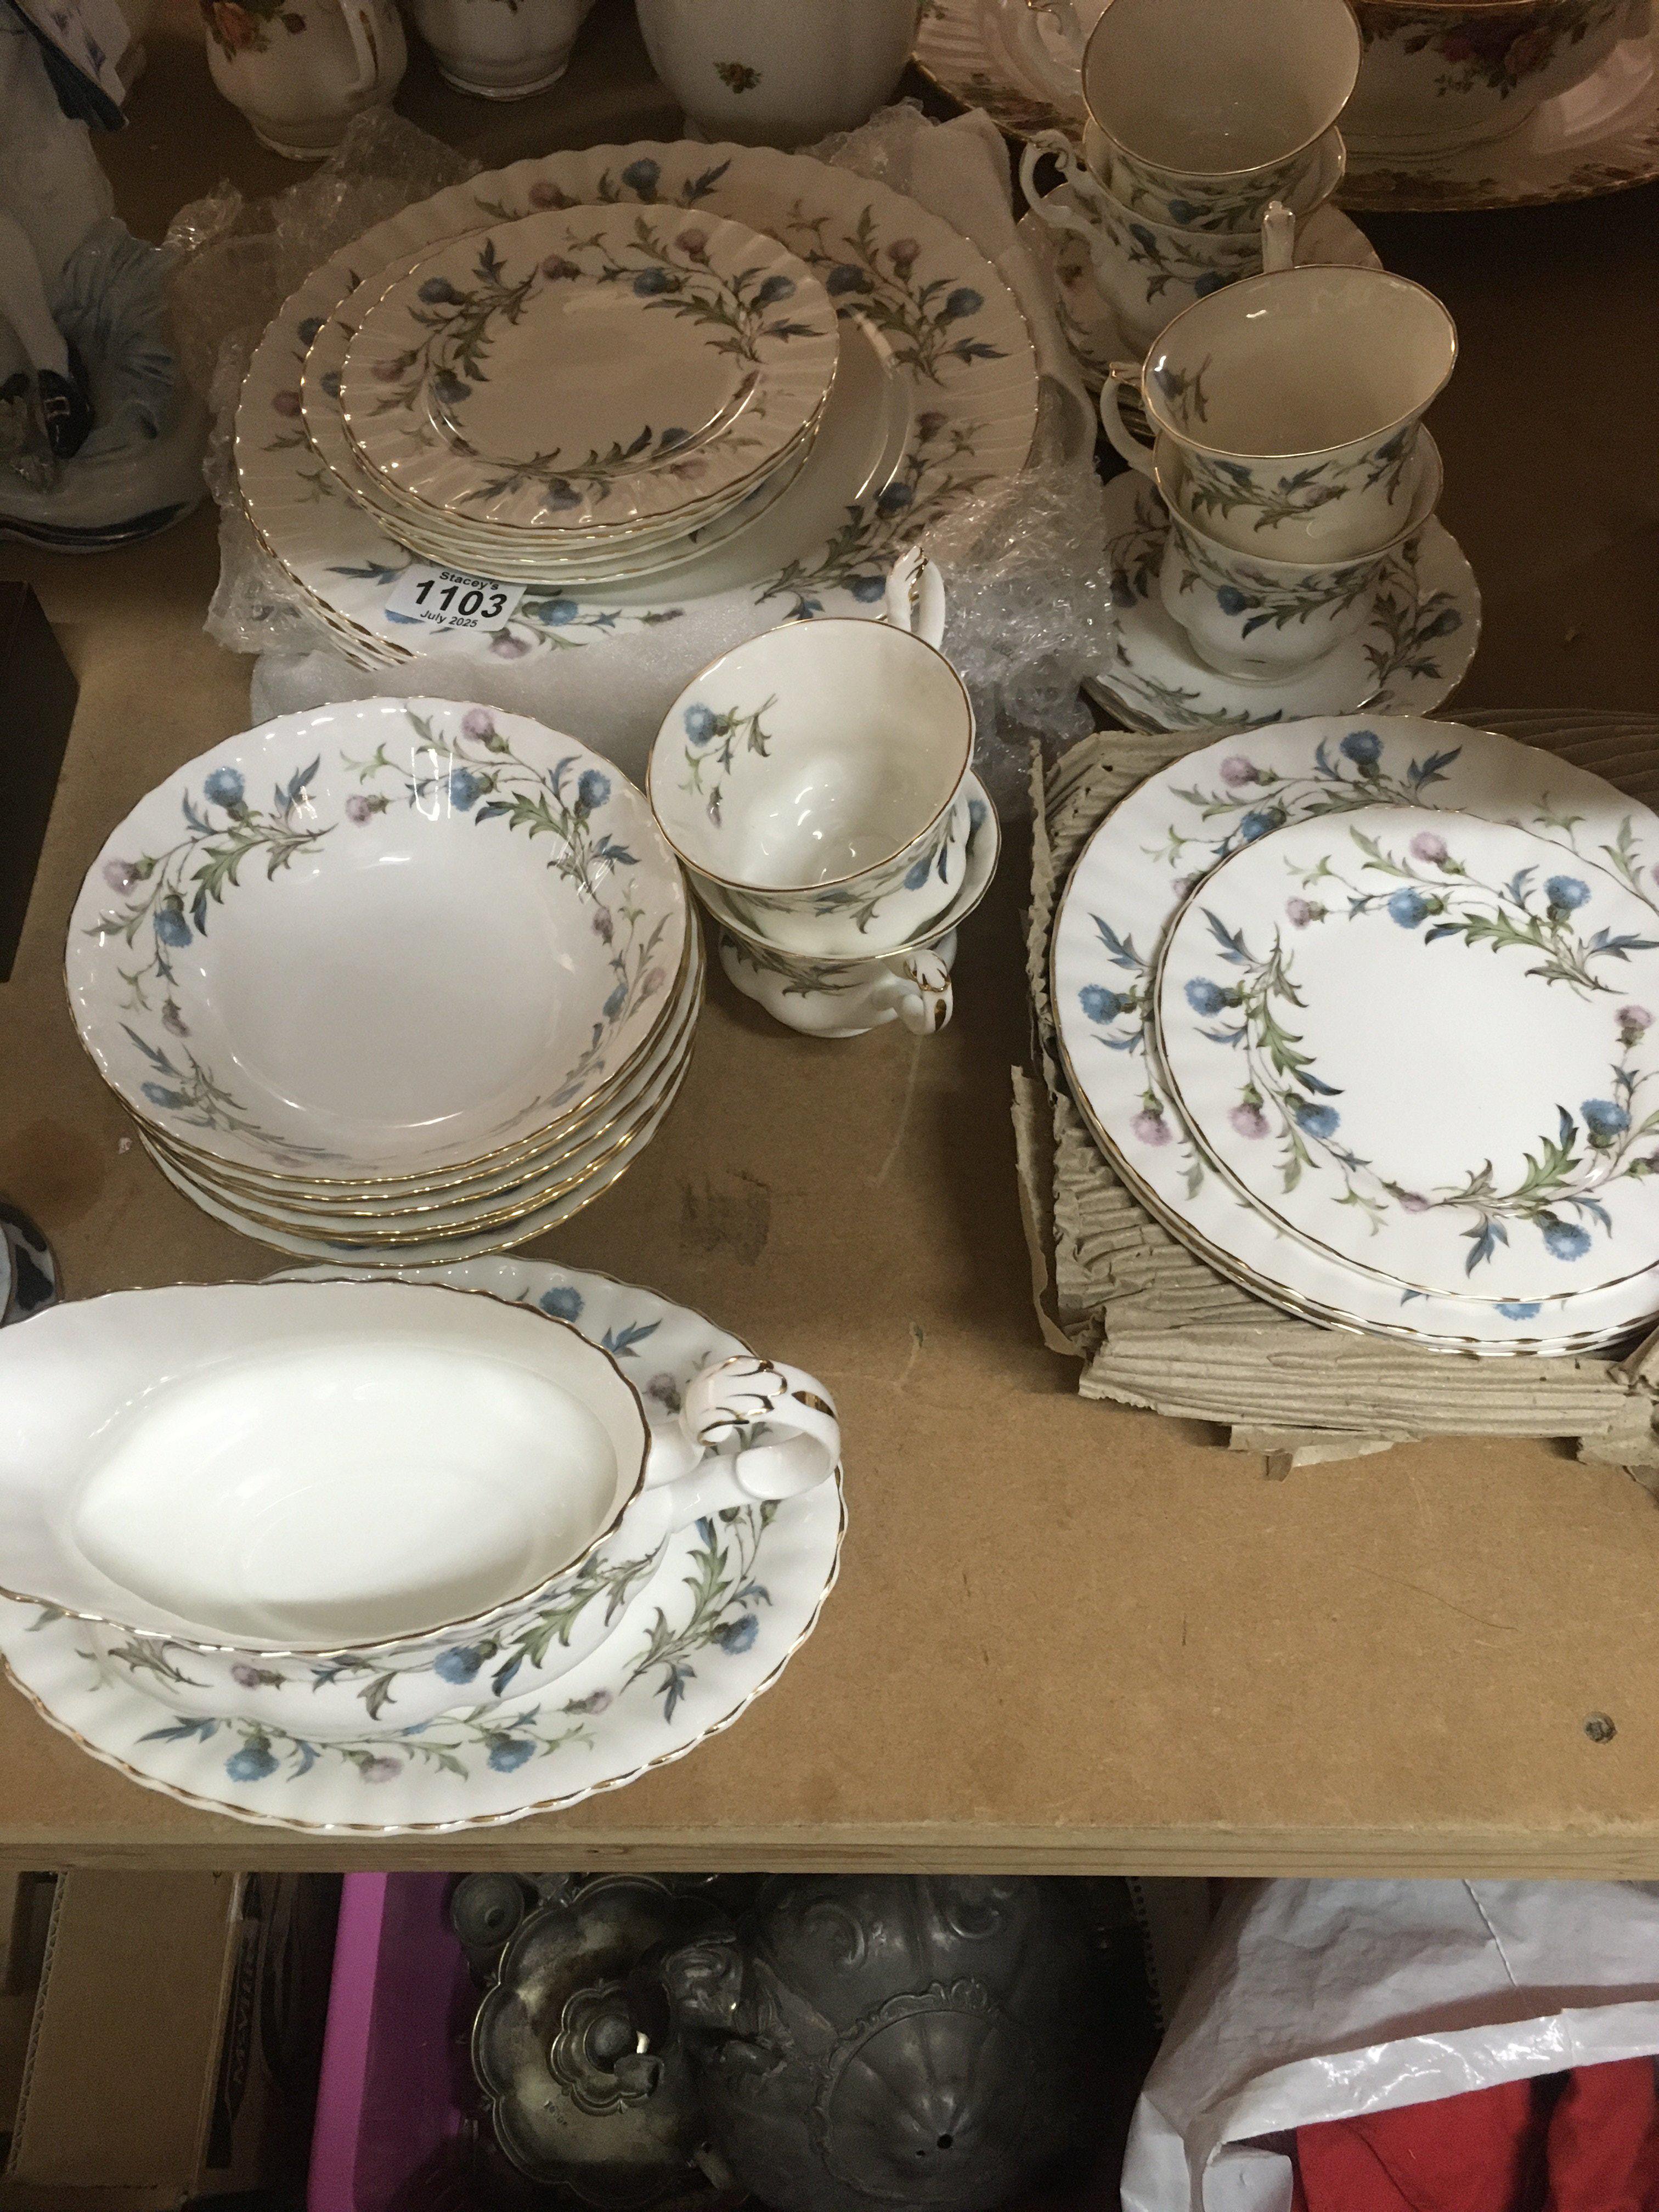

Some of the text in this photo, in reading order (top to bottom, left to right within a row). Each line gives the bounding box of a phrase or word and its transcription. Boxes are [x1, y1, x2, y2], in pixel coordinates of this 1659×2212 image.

[439, 571, 499, 590] Stacey's
[415, 580, 507, 618] 1103
[420, 610, 478, 628] July 2025
